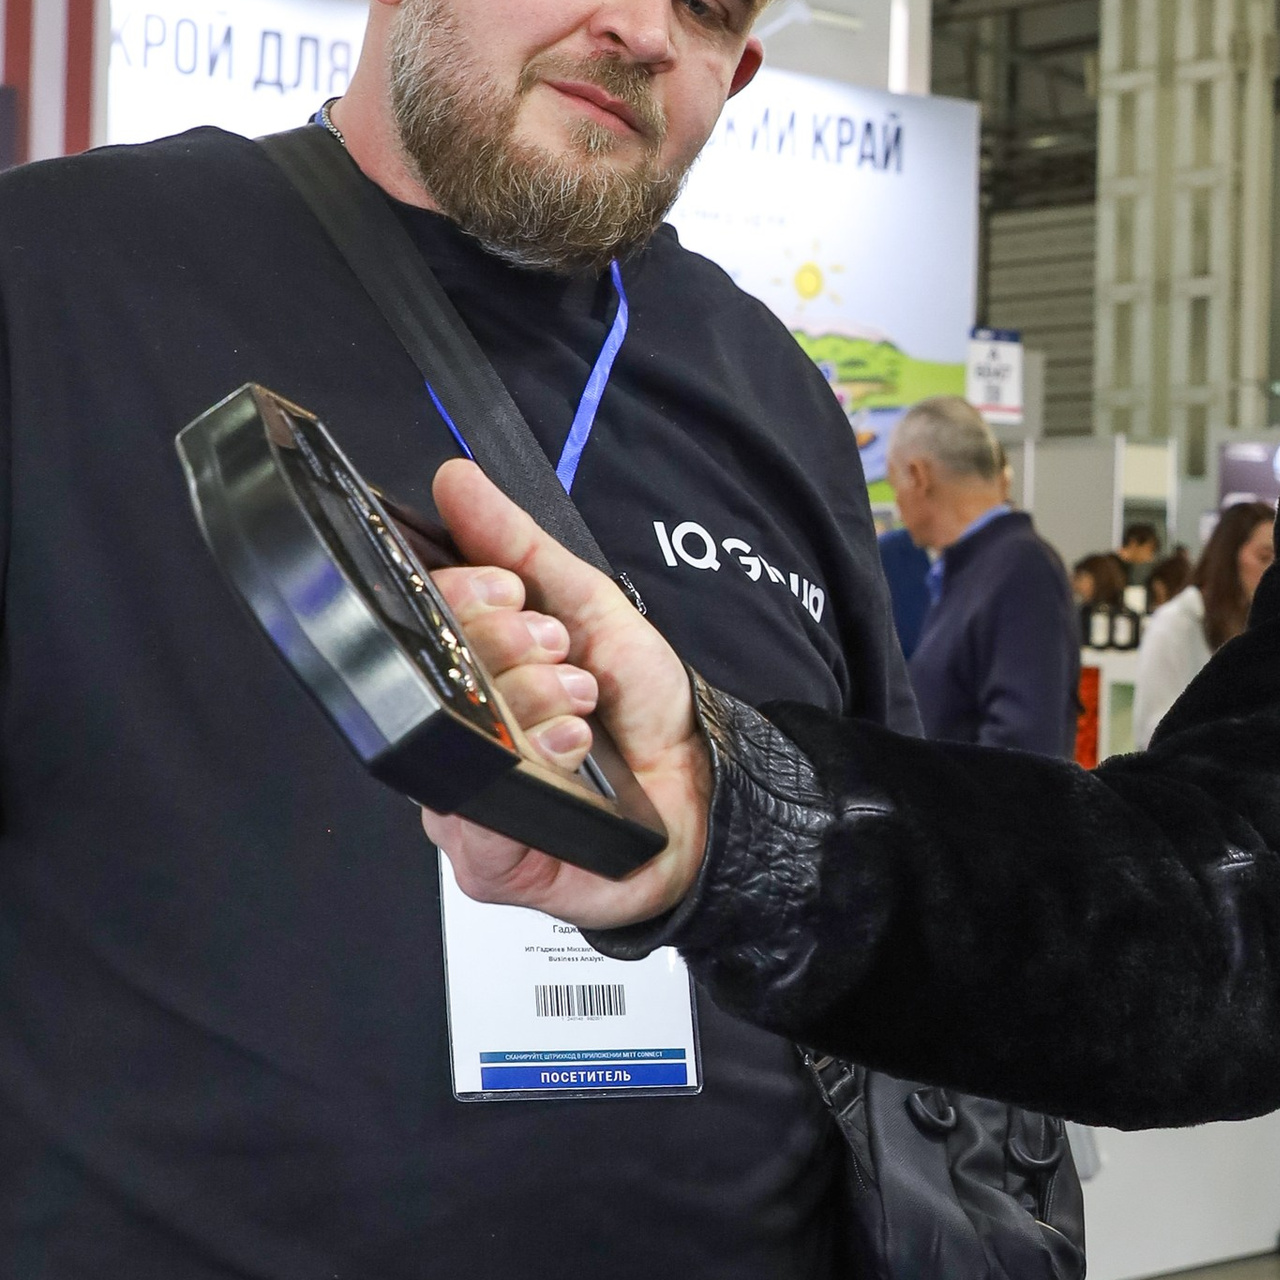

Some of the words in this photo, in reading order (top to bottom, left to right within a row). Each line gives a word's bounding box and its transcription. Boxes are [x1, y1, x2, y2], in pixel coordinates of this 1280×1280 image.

[253, 29, 350, 94] ДЛЯ
[812, 111, 903, 174] КРАЙ
[653, 521, 721, 571] IQ
[552, 925, 580, 934] Гадж
[505, 1052, 543, 1061] СКАНИРУЙТЕ
[582, 1051, 623, 1059] ПРИЛОЖЕНИИ
[541, 1070, 631, 1083] ПОСЕТИТЕЛЬ
